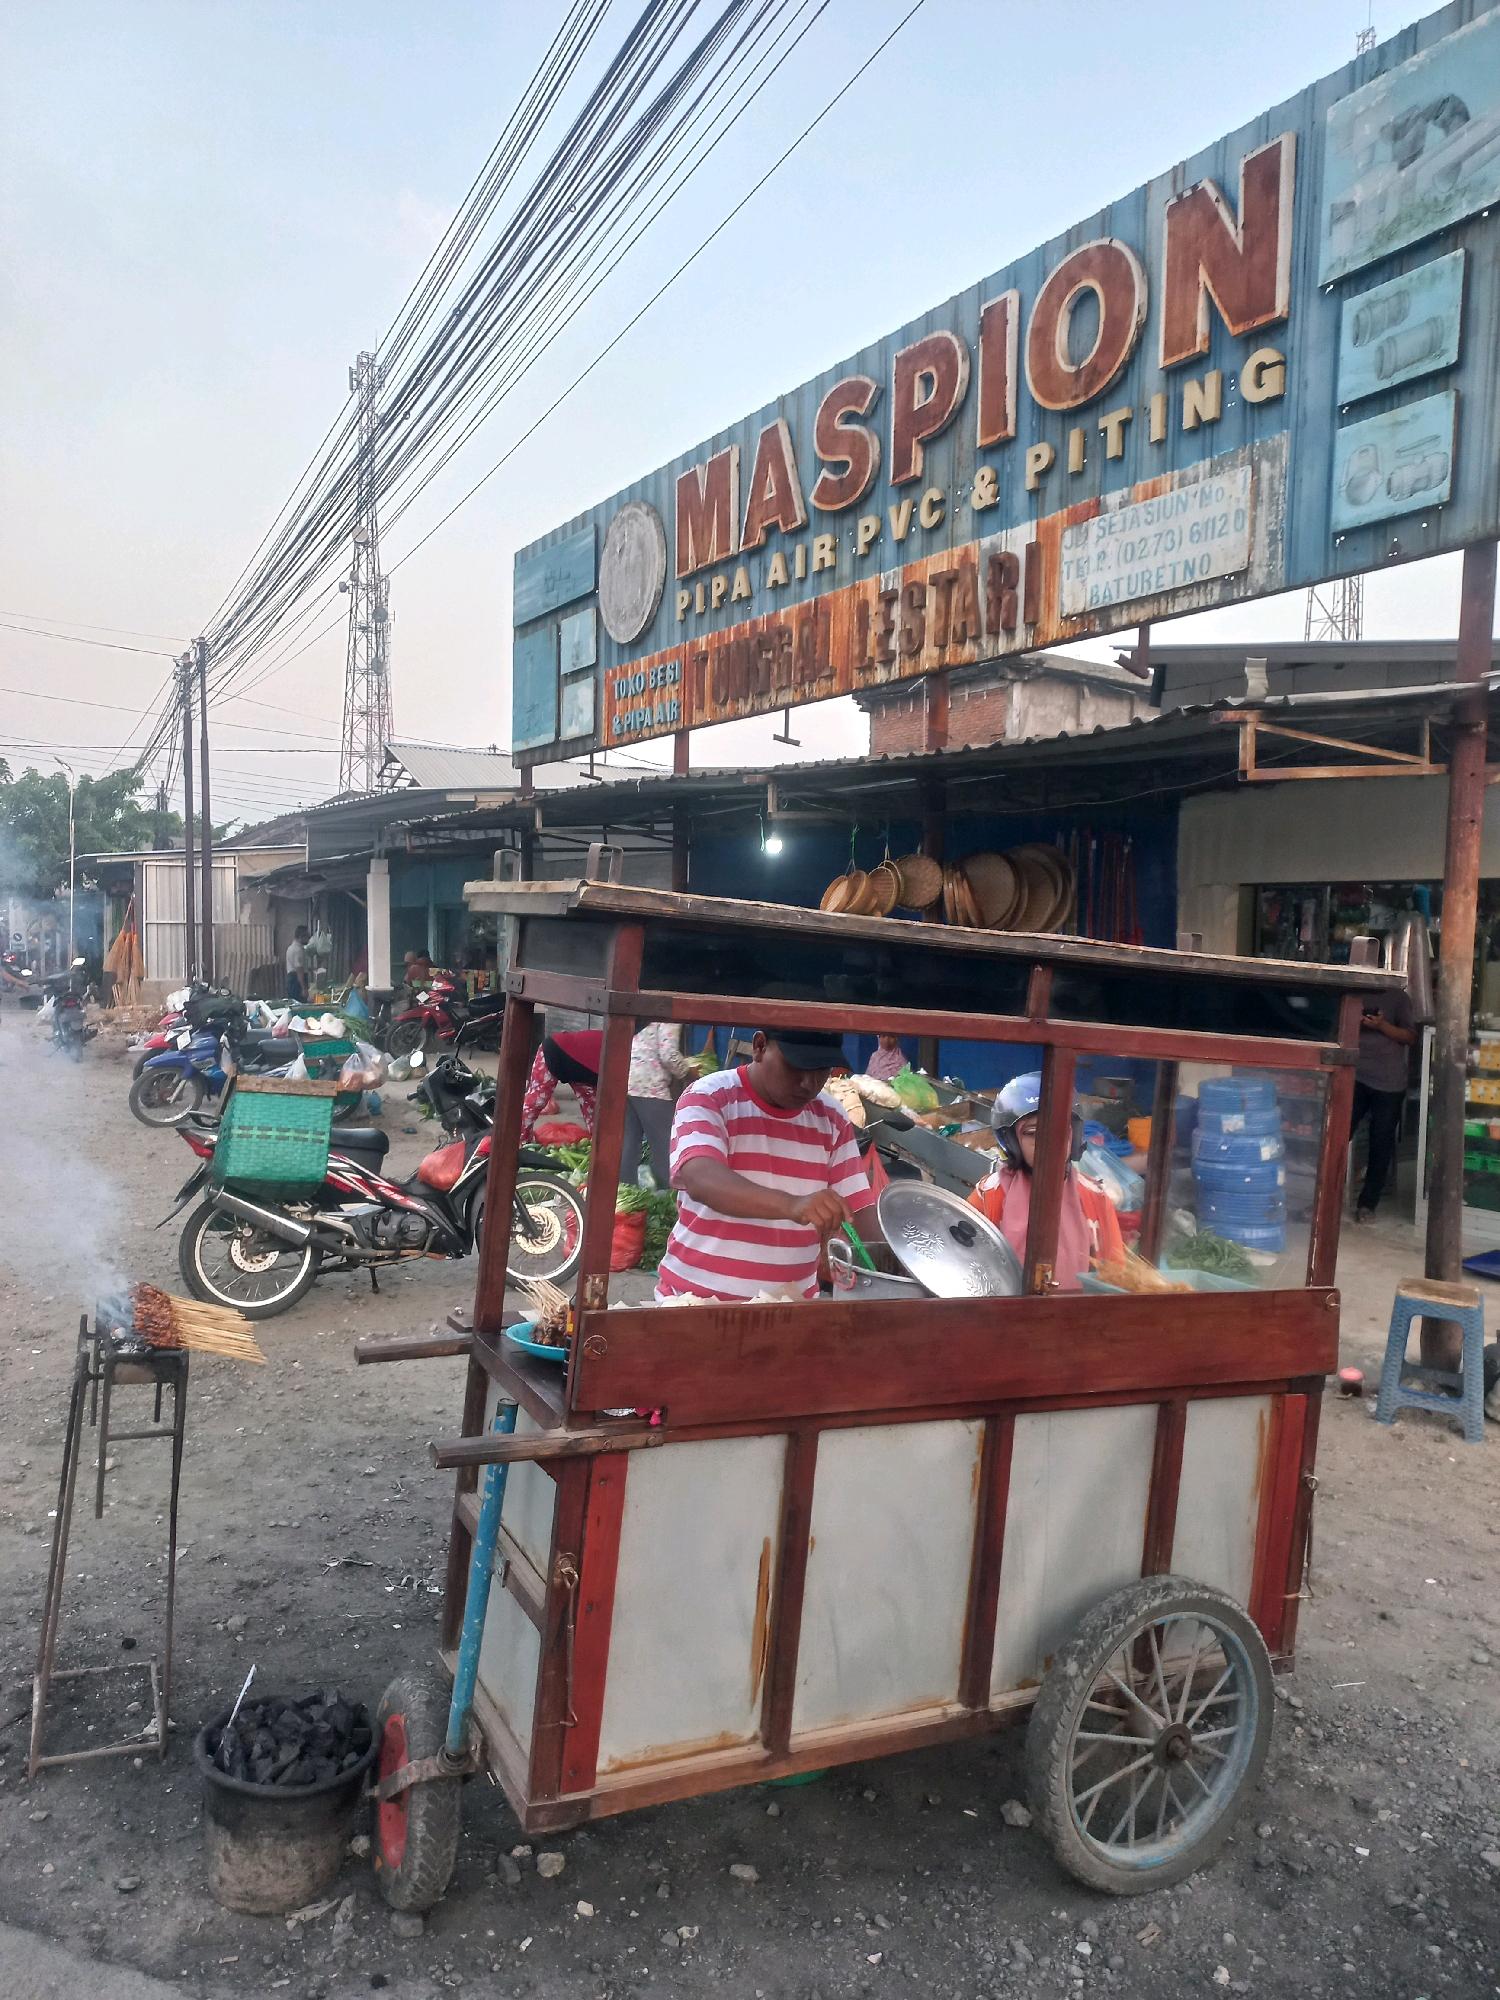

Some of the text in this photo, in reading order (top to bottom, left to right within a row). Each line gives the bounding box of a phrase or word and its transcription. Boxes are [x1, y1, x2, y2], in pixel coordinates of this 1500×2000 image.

[676, 131, 1296, 580] MASPION
[676, 347, 1287, 622] PIPA AIR PVC & PITING
[692, 540, 1042, 710] TUNGGAL LESTARI
[1089, 552, 1212, 608] BATURETNO
[612, 698, 681, 736] & PIPA AIR
[613, 658, 682, 700] TOKO BESI
